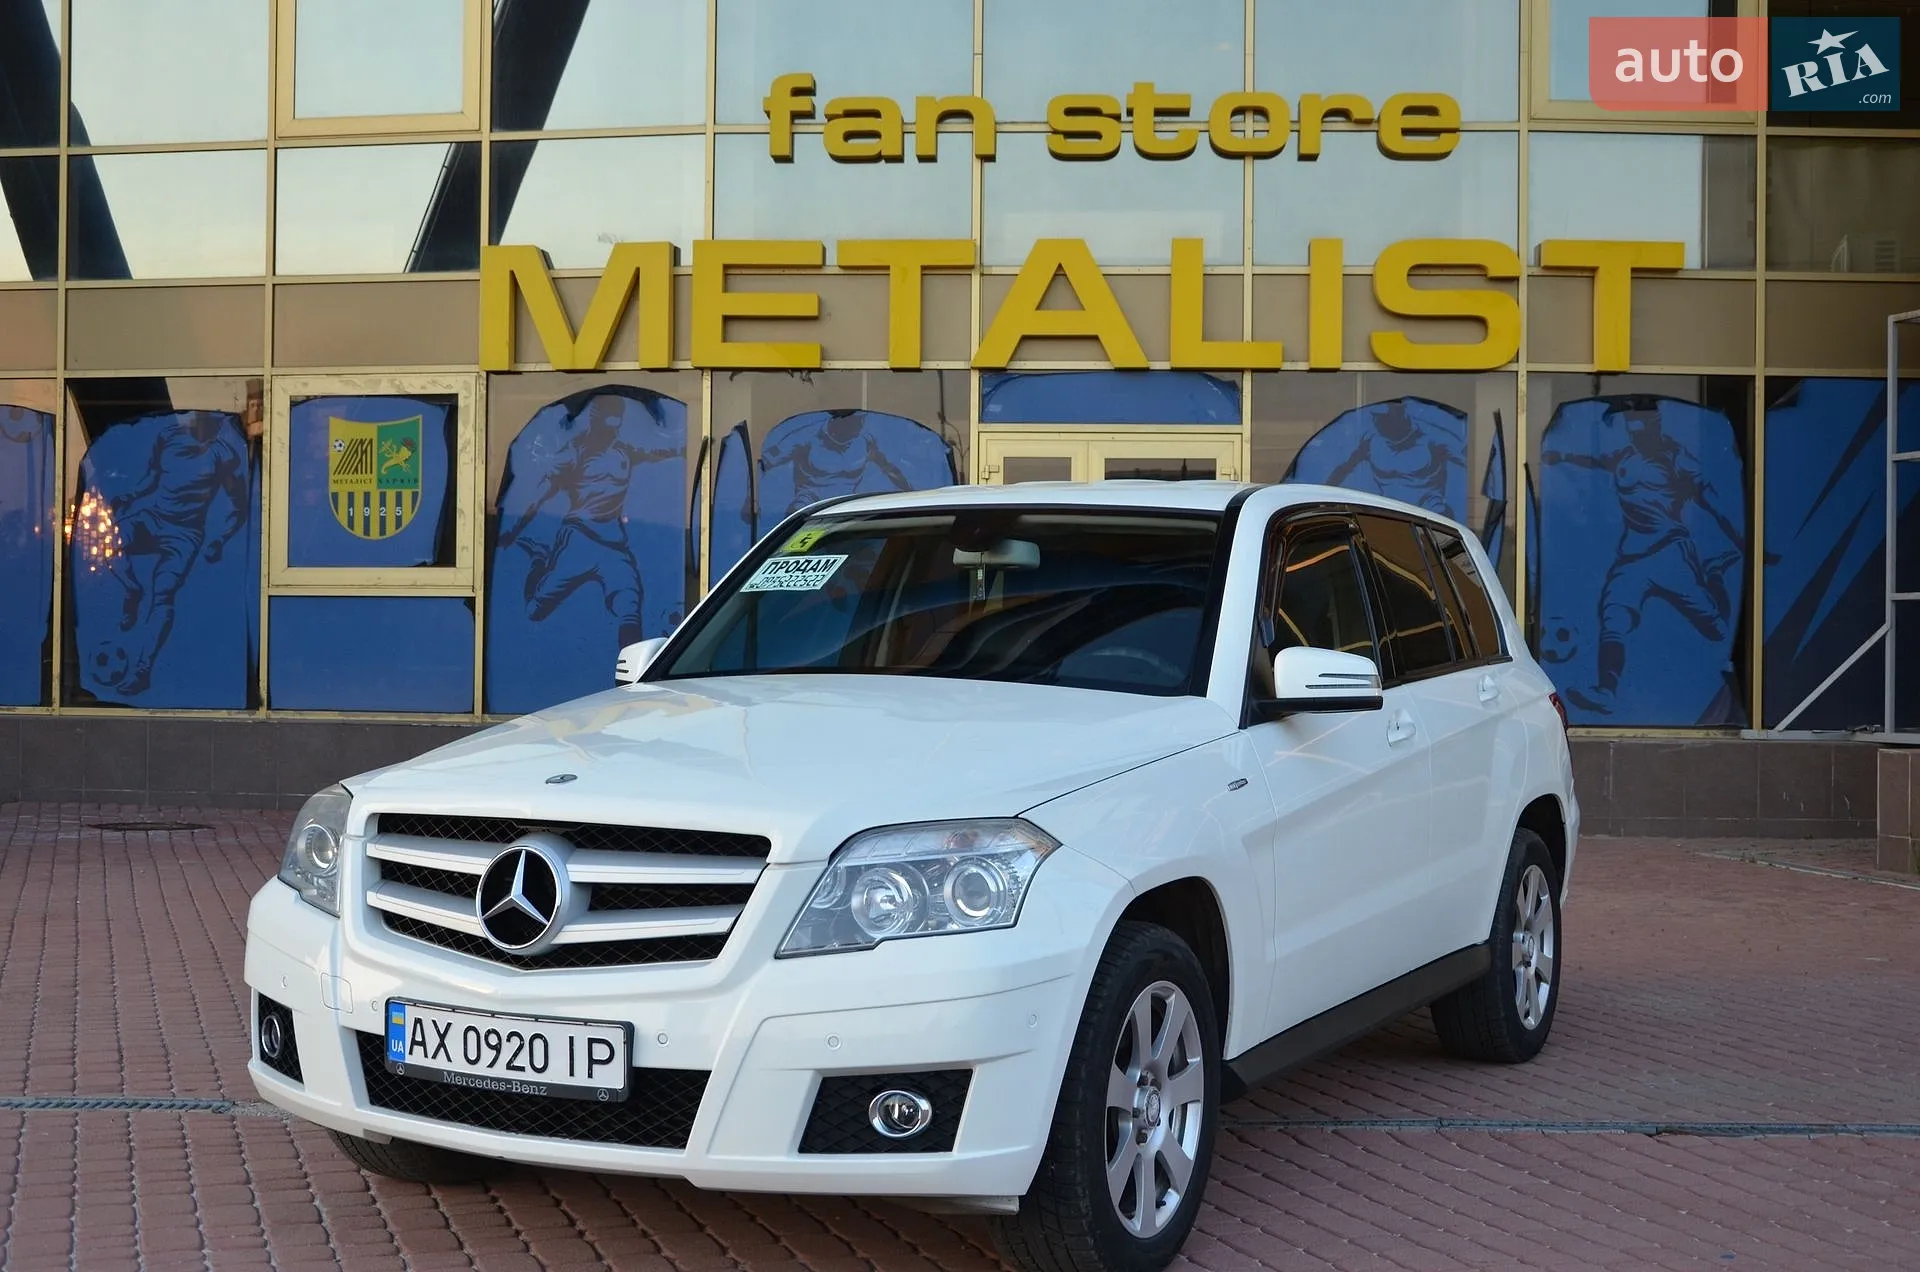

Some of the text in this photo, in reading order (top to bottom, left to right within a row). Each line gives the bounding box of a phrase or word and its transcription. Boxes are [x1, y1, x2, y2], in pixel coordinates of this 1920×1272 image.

[763, 72, 1462, 163] fan store
[479, 237, 1686, 374] METALIST
[761, 558, 839, 575] ПРОДАМ
[391, 1039, 405, 1054] UA
[408, 1016, 616, 1079] AX 0920 IP
[443, 1070, 548, 1097] Mercedes-Benz
